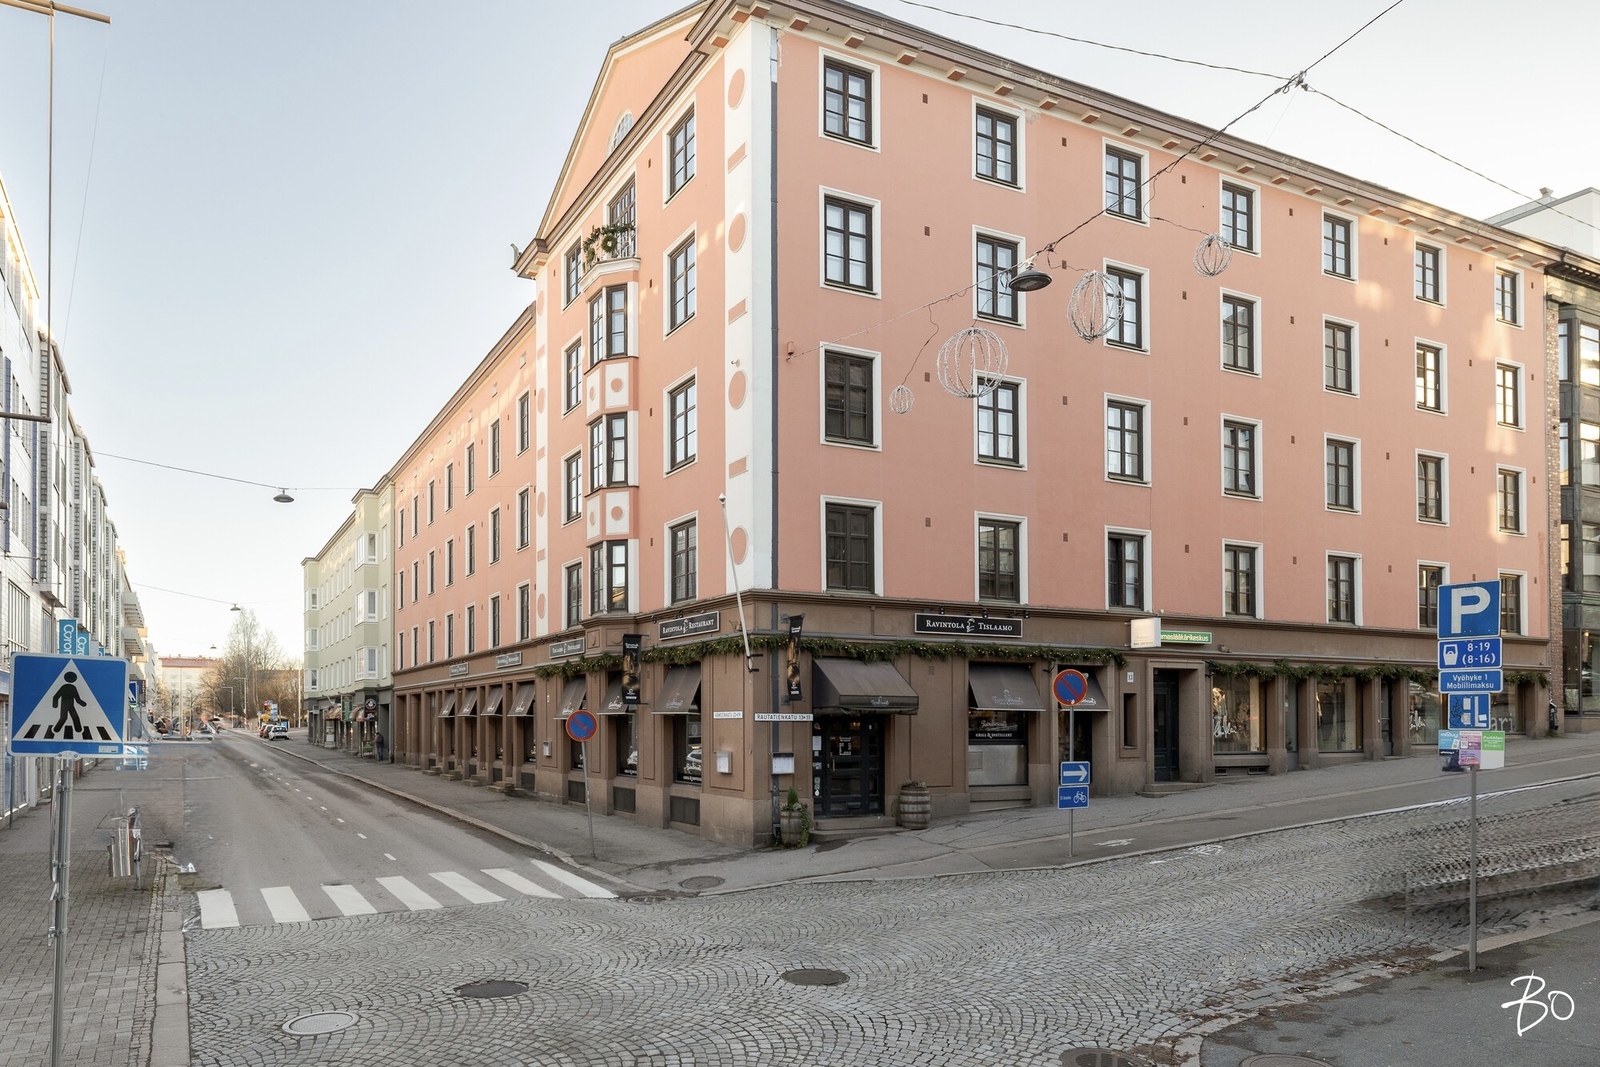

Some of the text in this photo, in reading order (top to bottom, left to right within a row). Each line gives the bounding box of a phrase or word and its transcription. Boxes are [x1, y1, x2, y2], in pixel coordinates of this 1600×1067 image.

[1451, 587, 1490, 634] P
[662, 619, 714, 634] RAVINTOLA RESTAURANT
[926, 619, 1013, 631] RAVINTOLA TISLAAMO
[63, 624, 74, 655] Coron
[1467, 642, 1490, 652] 8-19
[1462, 653, 1496, 665] (8-16)
[1452, 674, 1482, 683] Vyöhyke
